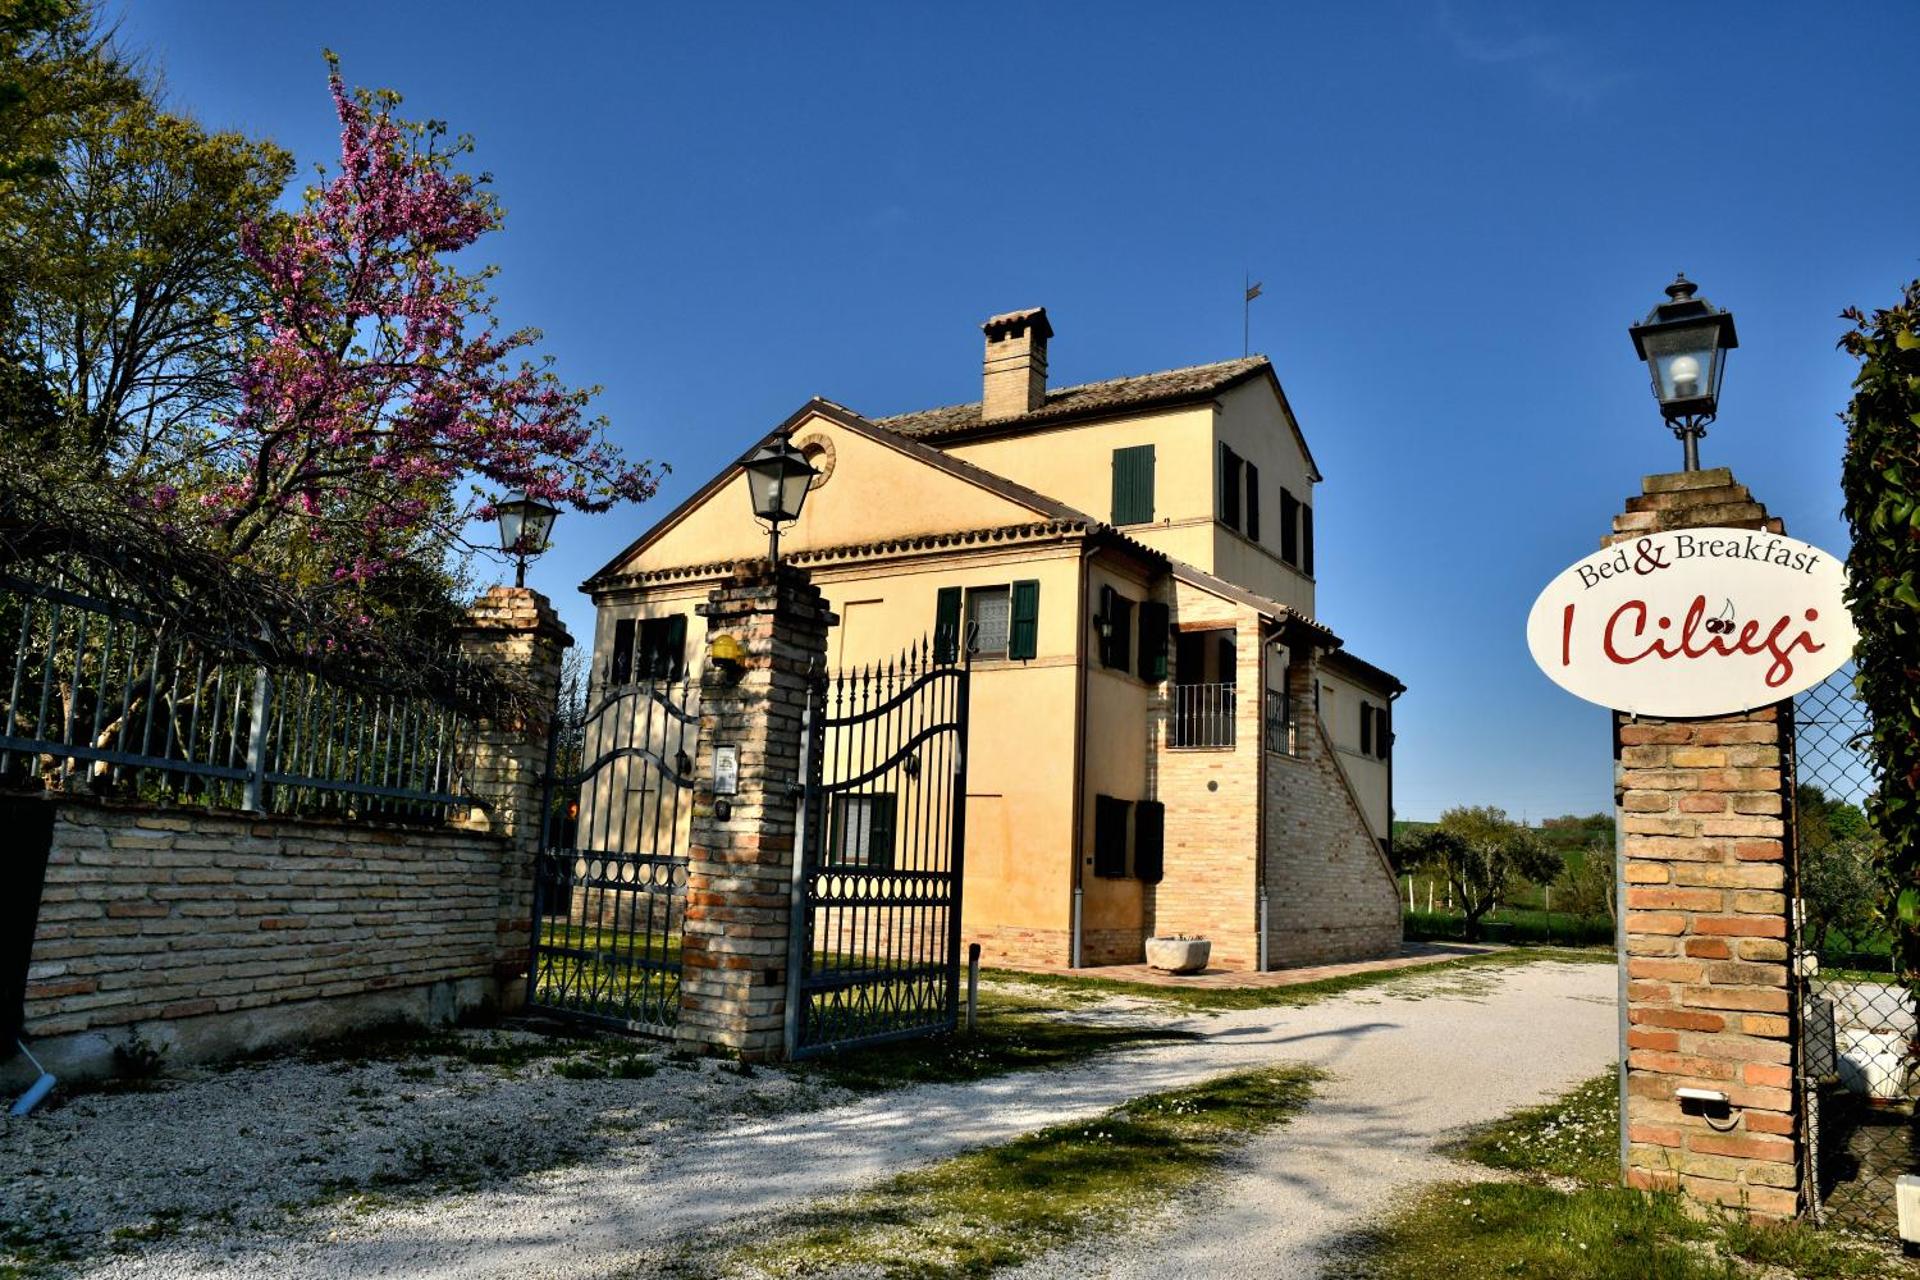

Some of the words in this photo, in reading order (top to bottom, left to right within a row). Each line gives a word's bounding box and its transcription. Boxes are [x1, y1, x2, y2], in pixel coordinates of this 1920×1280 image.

[1575, 550, 1631, 590] Bed
[1633, 538, 1671, 576] &
[1675, 533, 1821, 575] Breakfast
[1562, 603, 1575, 667] I
[1603, 594, 1826, 688] Ciliegi
